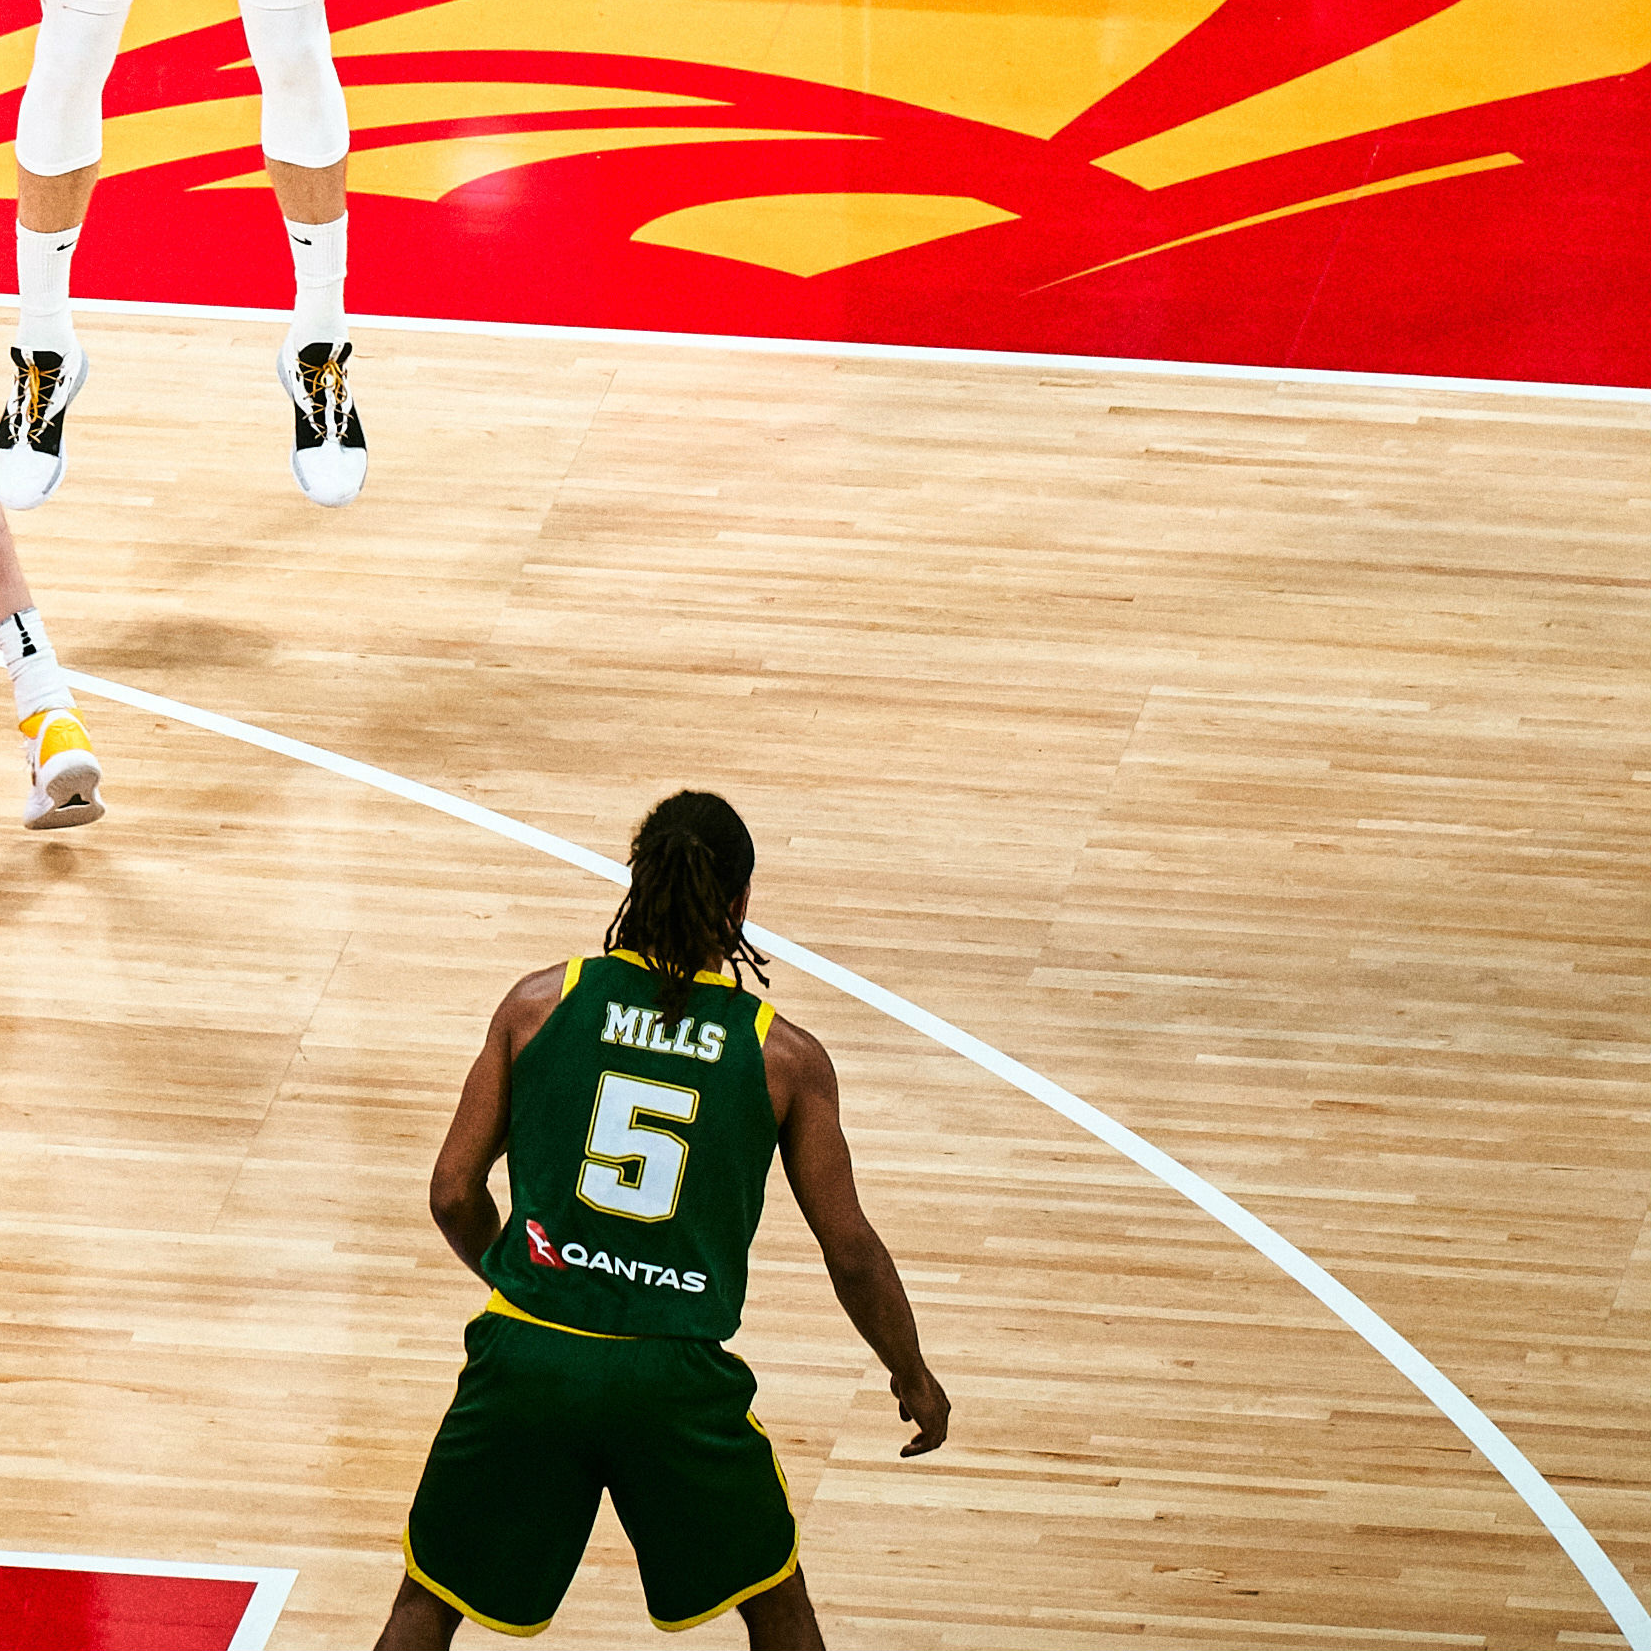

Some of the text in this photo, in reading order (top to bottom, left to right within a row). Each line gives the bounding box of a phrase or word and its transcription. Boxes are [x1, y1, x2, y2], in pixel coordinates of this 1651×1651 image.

[600, 1002, 727, 1064] MILLS
[576, 1069, 700, 1224] 5
[561, 1240, 708, 1293] QANTAS
